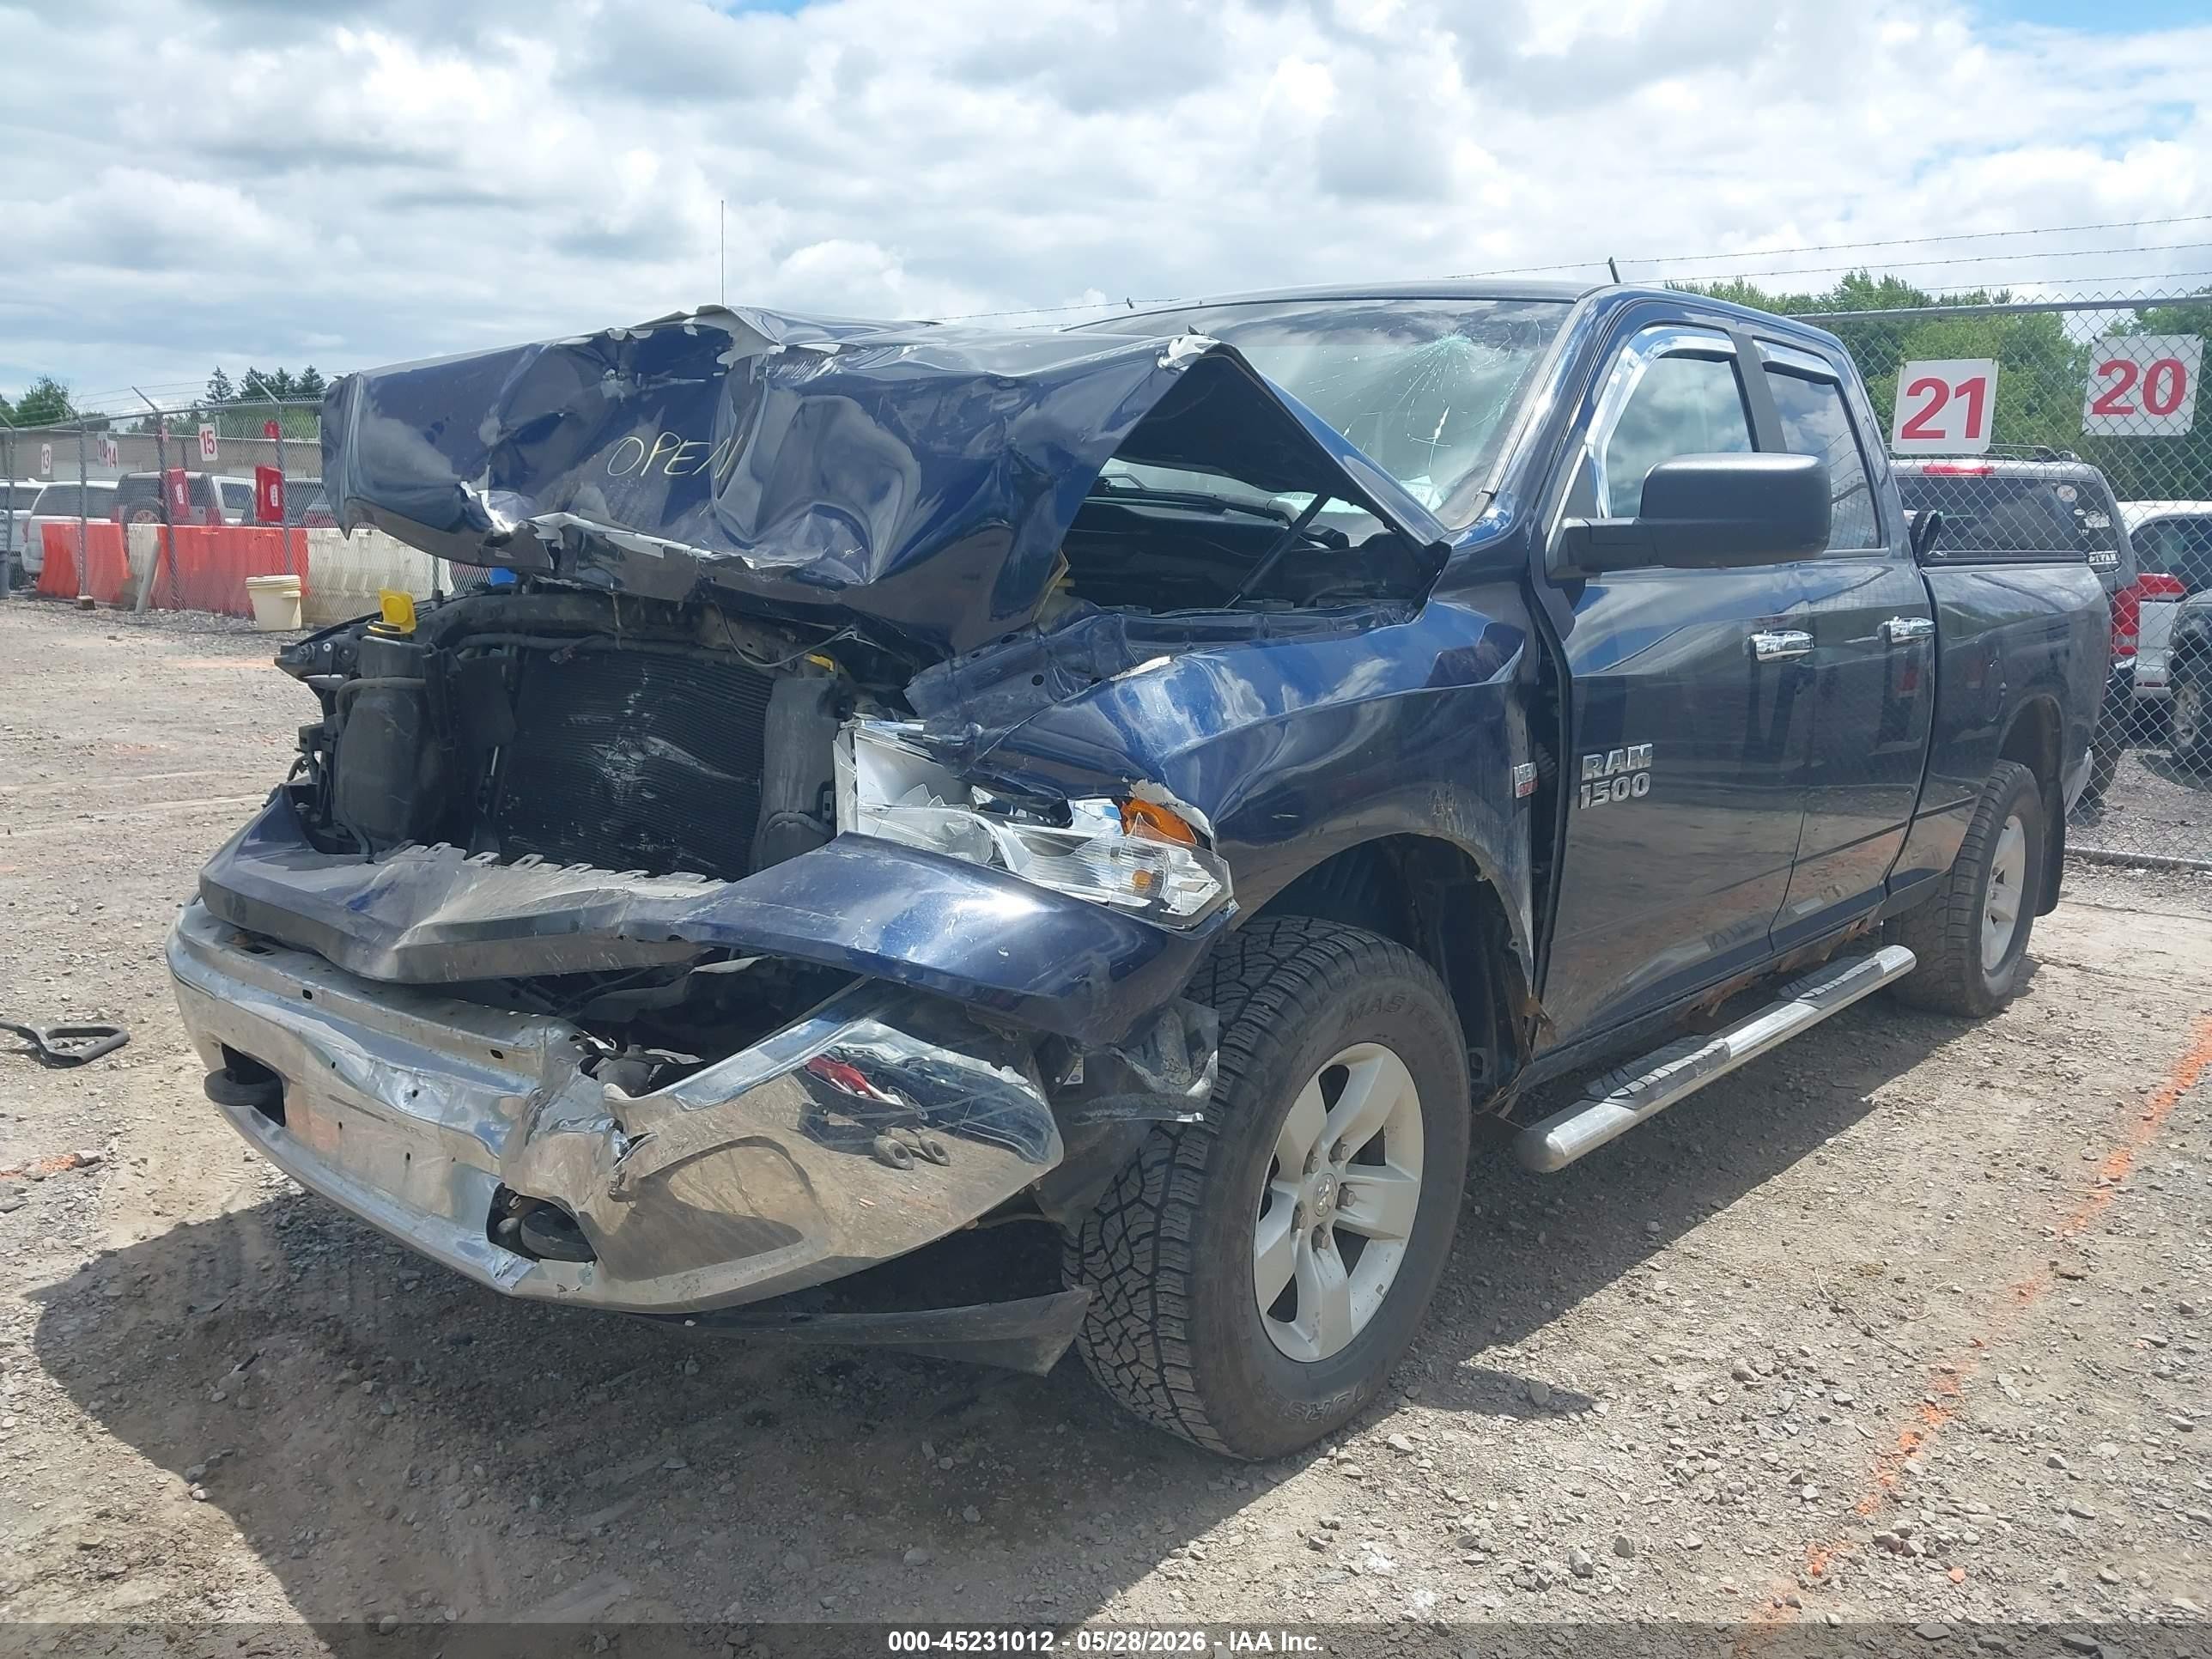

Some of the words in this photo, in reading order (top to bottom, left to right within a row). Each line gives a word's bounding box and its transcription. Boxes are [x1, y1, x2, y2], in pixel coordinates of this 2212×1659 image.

[2090, 357, 2188, 416] 20
[1900, 377, 1987, 440] 21
[41, 449, 50, 470] 13
[107, 447, 118, 468] 14
[201, 430, 216, 455] 15
[607, 431, 744, 479] OPEN
[1581, 743, 1654, 781] RAM
[1579, 771, 1651, 810] 1500
